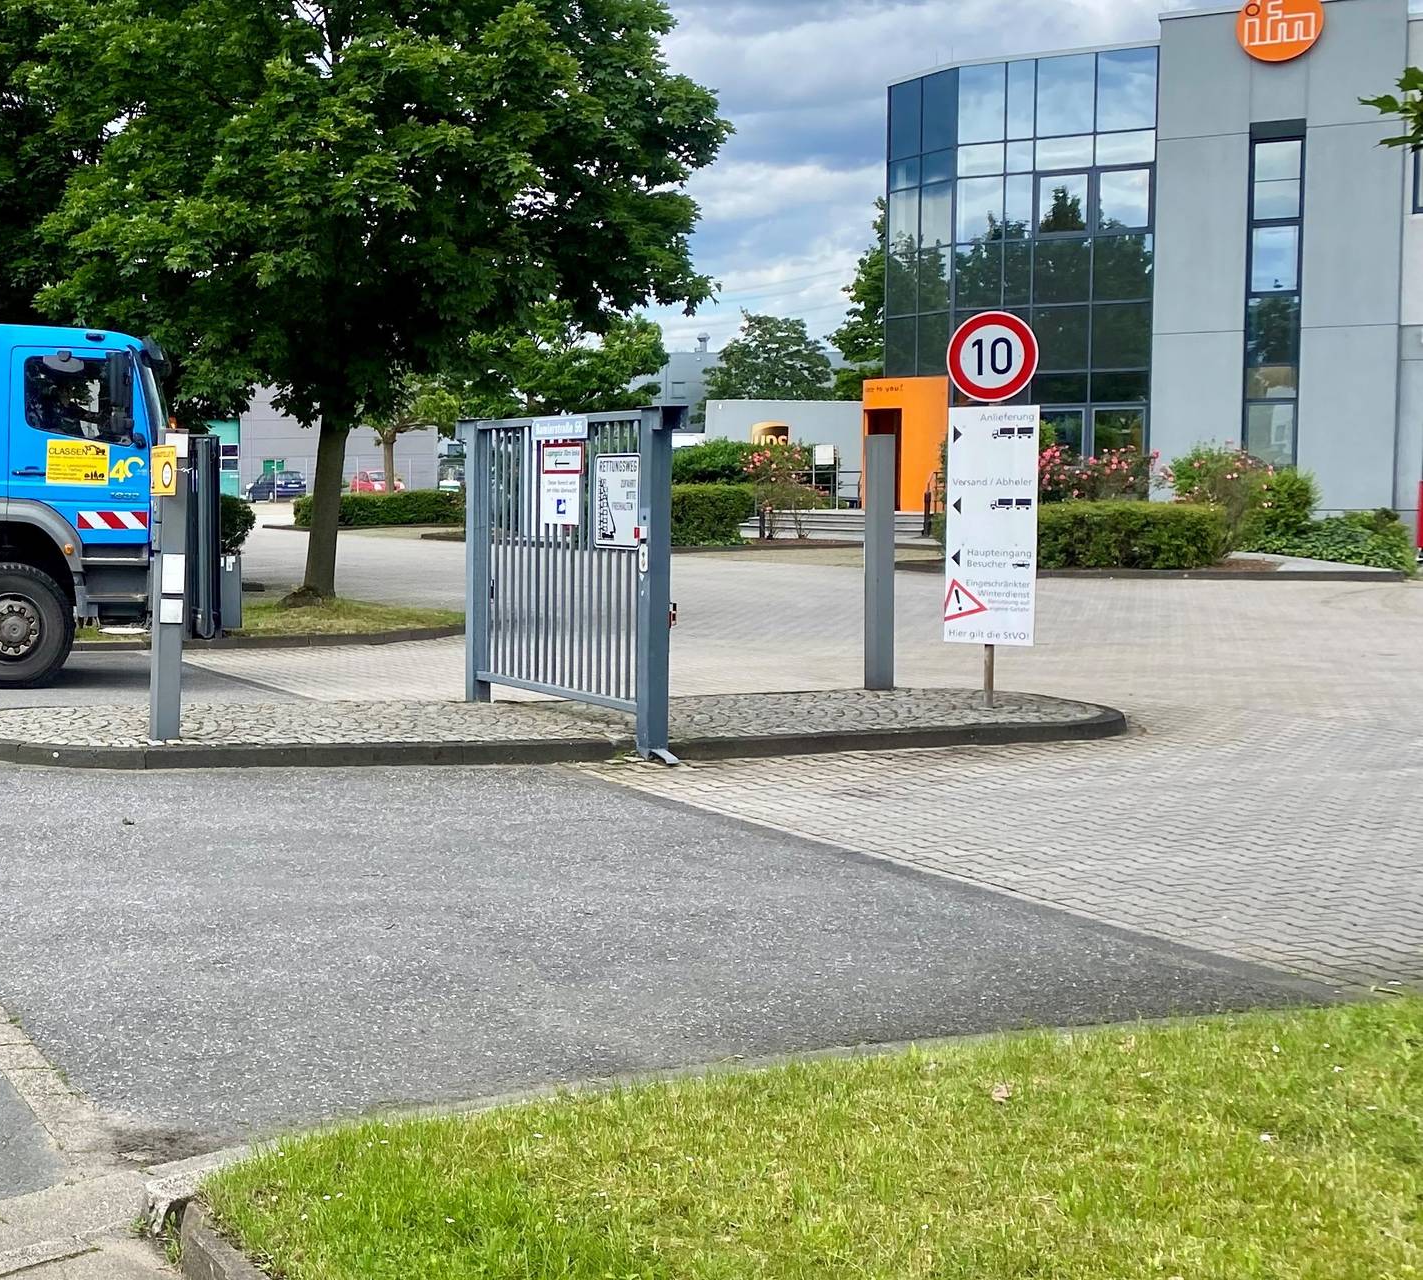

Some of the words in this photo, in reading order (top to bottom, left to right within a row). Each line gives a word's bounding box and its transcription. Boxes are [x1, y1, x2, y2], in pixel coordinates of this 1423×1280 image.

[1243, 0, 1316, 47] ifm
[971, 336, 1013, 376] 10
[979, 413, 1035, 422] Anlieferung
[48, 447, 88, 456] CLASSEN
[599, 460, 638, 473] RETTUNGSWEG
[952, 477, 988, 487] Versand
[995, 477, 1033, 487] Abholer
[966, 548, 1032, 559] Haupteingang
[966, 560, 1007, 568] Besucher
[965, 579, 1030, 588] Eingeschränkter
[977, 590, 1030, 599] Winterdienst
[948, 629, 966, 637] Hier
[969, 630, 984, 639] gilt
